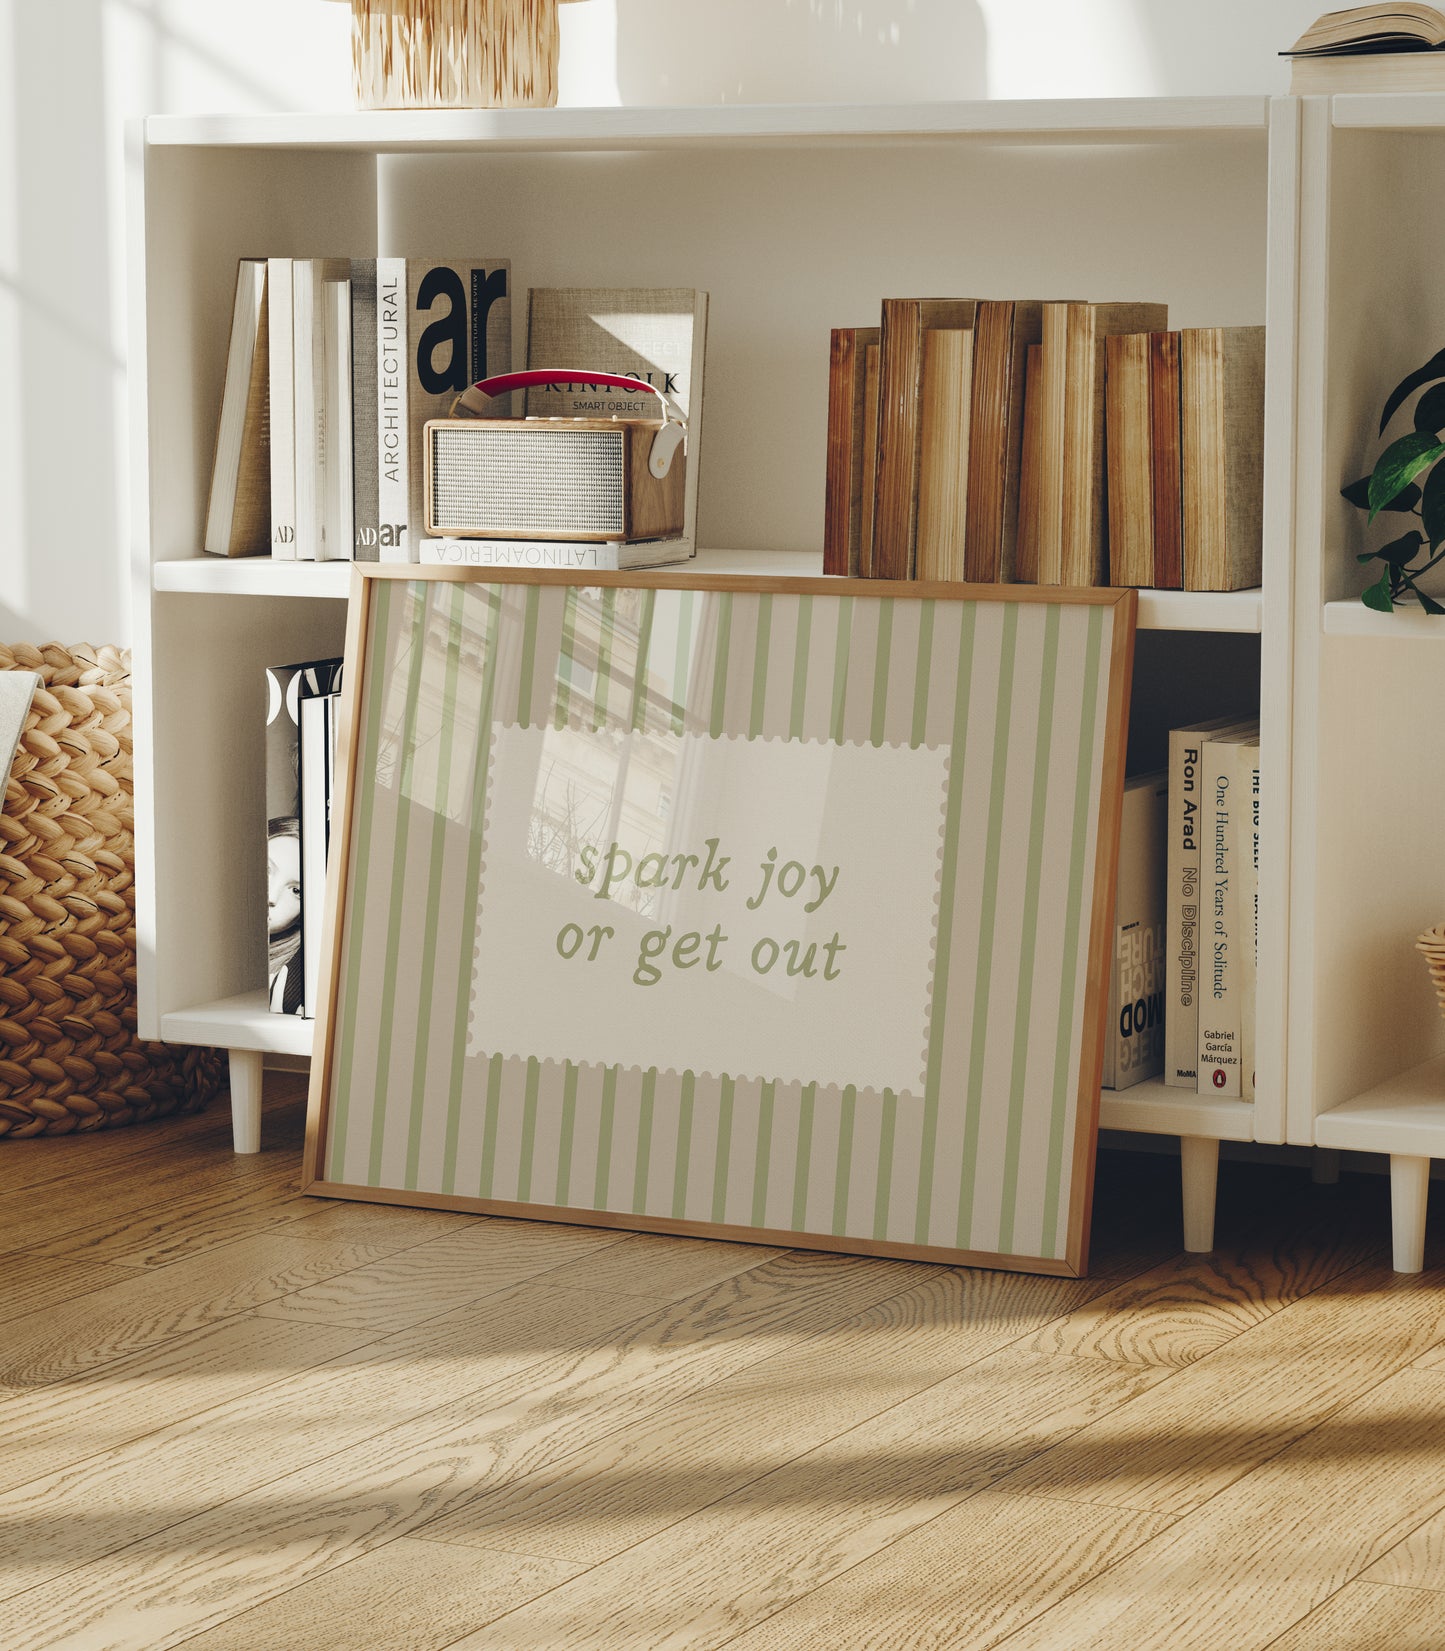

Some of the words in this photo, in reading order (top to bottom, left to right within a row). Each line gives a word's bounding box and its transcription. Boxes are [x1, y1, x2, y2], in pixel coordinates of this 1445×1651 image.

[416, 266, 507, 395] ar
[382, 276, 399, 483] ARCHITECTURAL
[573, 400, 606, 412] SMART
[607, 401, 646, 412] OBJECT
[274, 525, 294, 543] AD
[355, 526, 378, 546] AD
[379, 523, 408, 547] ar
[435, 544, 598, 567] LATINOAMERICA
[1183, 748, 1198, 792] Ron
[1216, 775, 1230, 807] One
[1183, 798, 1198, 850] Arad
[1215, 812, 1229, 874] Hundred
[574, 837, 732, 900] spark
[746, 846, 840, 914] joy
[1182, 867, 1198, 897] No
[1214, 879, 1229, 917] Years
[1214, 920, 1228, 938] of
[556, 922, 616, 962] or
[632, 923, 729, 986] get
[751, 931, 847, 982] out
[1178, 904, 1197, 1007] Discipline
[1213, 942, 1228, 999] Solitude
[1203, 1030, 1235, 1041] Gabriel
[1205, 1042, 1232, 1053] García
[1176, 1069, 1197, 1078] MoMA
[1200, 1053, 1238, 1065] Márquez
